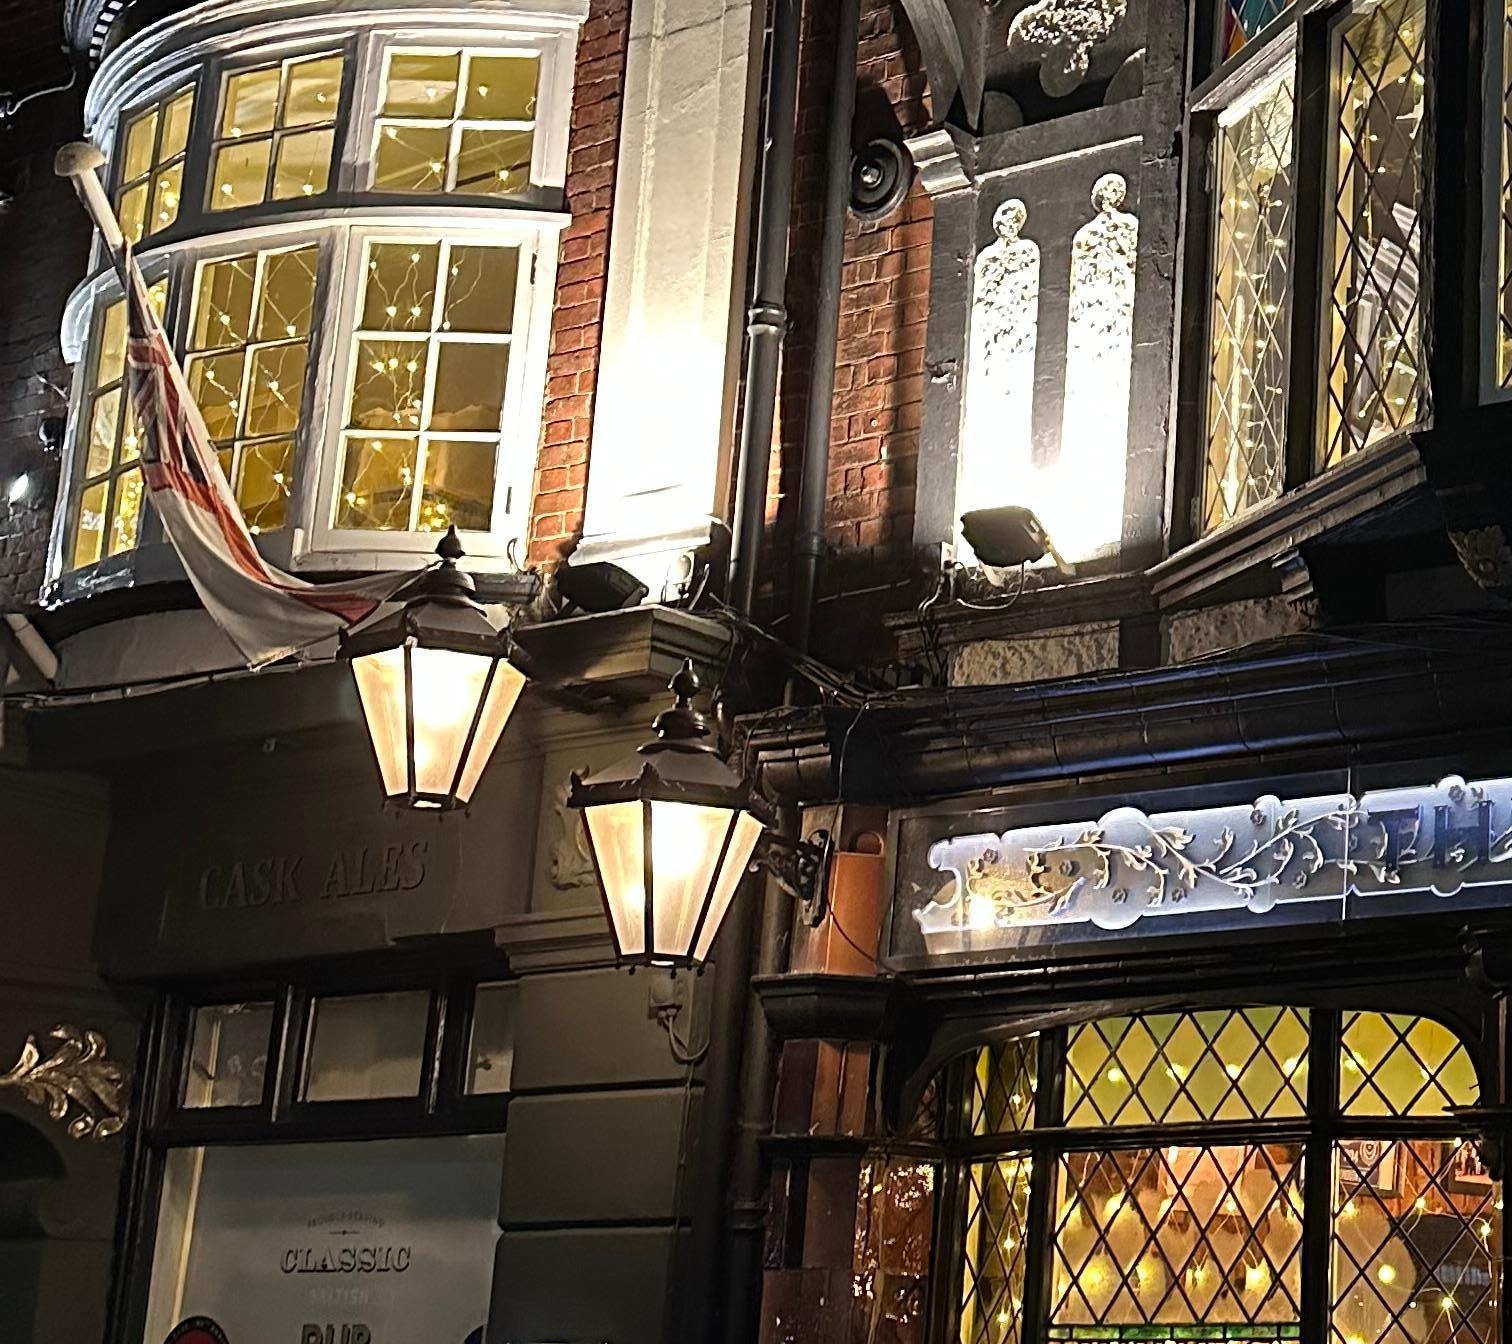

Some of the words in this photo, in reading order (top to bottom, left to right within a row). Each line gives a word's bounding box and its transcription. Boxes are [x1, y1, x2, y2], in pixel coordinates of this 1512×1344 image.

[201, 855, 303, 908] CASK
[319, 841, 429, 900] ALES
[280, 1245, 412, 1274] CLASSIC
